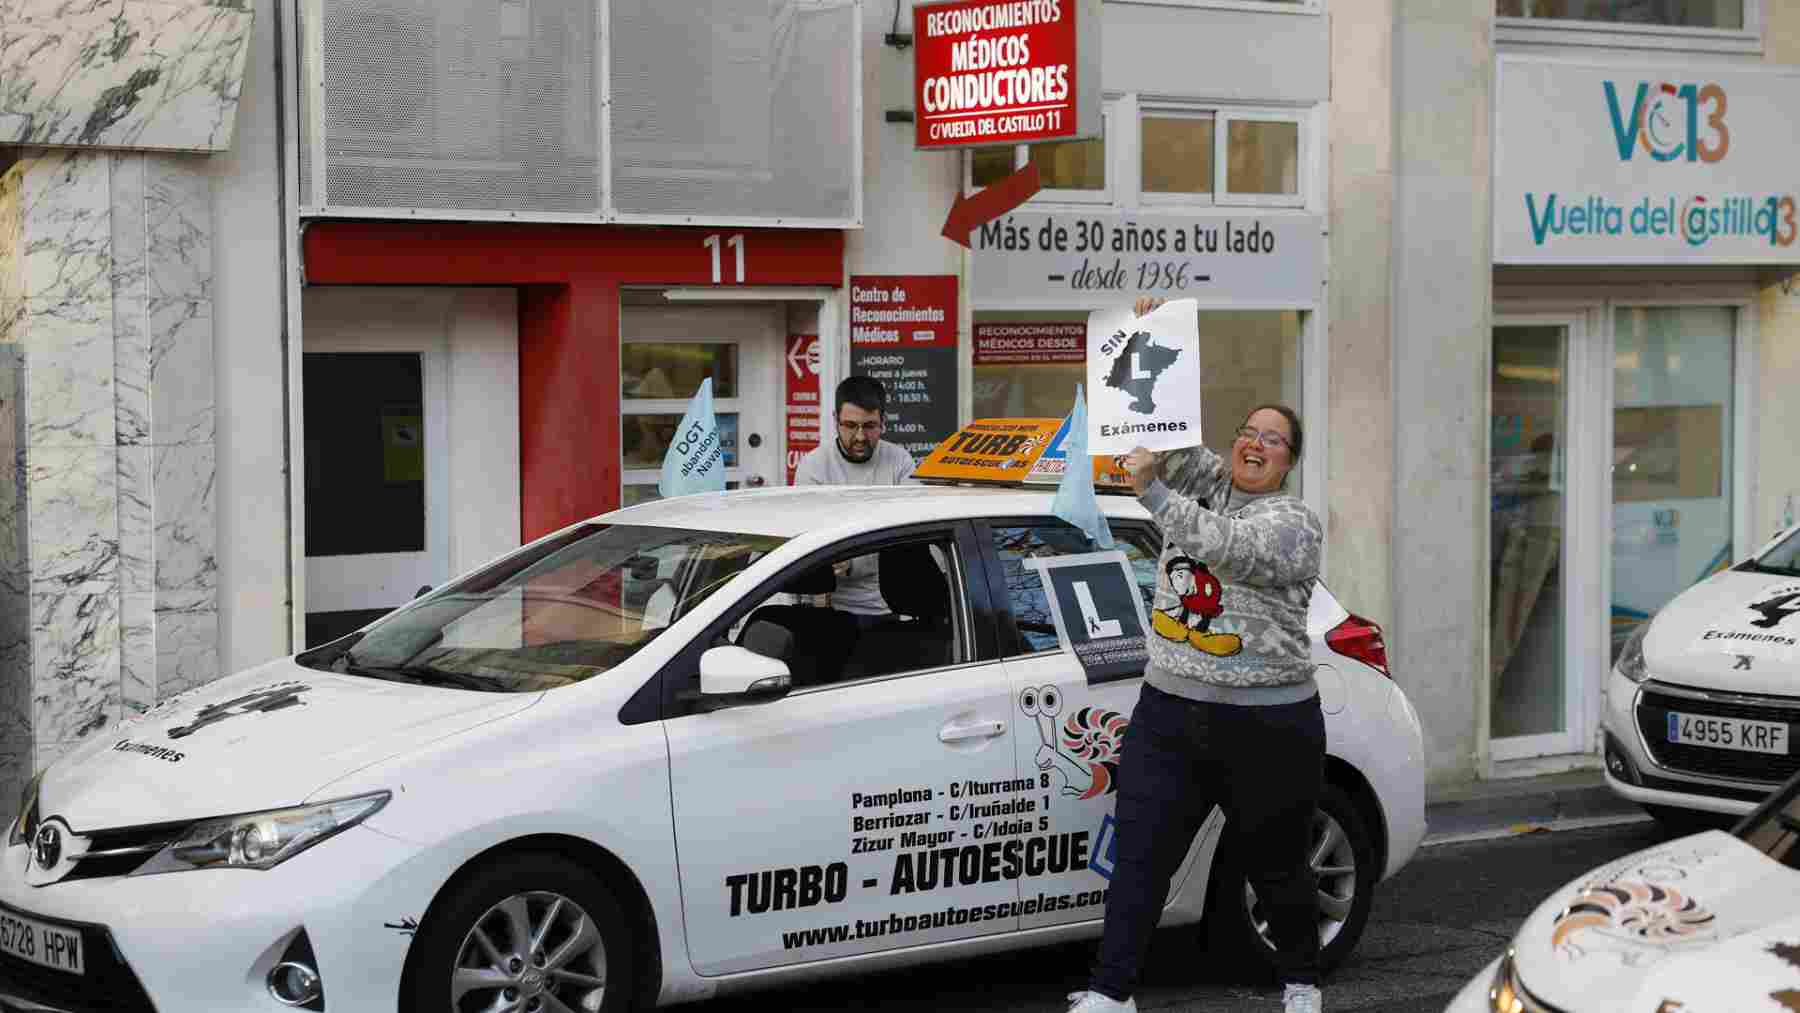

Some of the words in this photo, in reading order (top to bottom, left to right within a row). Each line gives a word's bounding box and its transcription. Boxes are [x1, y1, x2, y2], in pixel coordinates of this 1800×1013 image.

[927, 0, 1061, 37] RECONOCIMIENTOS
[951, 33, 1030, 72] MÉDICOS
[923, 64, 1069, 112] CONDUCTORES
[978, 118, 997, 136] DEL
[998, 114, 1045, 134] CASTILLO
[1046, 110, 1061, 131] 11
[980, 218, 1032, 252] Más
[1038, 217, 1068, 252] de
[1075, 220, 1105, 252] 30
[1110, 219, 1167, 253] años
[1174, 229, 1187, 252] a
[1194, 224, 1218, 253] tu
[1226, 221, 1275, 254] lado
[1525, 193, 1623, 246] Vuelta
[1630, 197, 1675, 235] del
[703, 233, 745, 284] 11
[1071, 257, 1129, 290] desde
[1135, 259, 1191, 290] 1986
[852, 286, 889, 303] Centro
[892, 286, 906, 302] de
[852, 306, 945, 323] Reconocimientos
[978, 326, 1085, 336] RECONOCIMIENTOS
[852, 326, 899, 343] Médicos
[1100, 329, 1127, 357] SIN
[1131, 352, 1152, 380] L
[676, 420, 704, 456] DGT
[1100, 421, 1188, 438] Exámenes
[1072, 581, 1124, 639] L
[1682, 717, 1734, 745] 4955
[1741, 724, 1785, 750] KRF
[852, 786, 933, 809] Pamplona
[950, 776, 1035, 799] C/Iturrama
[1039, 773, 1050, 789] 8
[852, 809, 931, 833] Berriozar
[949, 797, 1036, 822] C/Iruñalde
[1042, 795, 1050, 811] 1
[852, 836, 894, 854] Zizur
[900, 829, 954, 849] Mayor
[973, 818, 1033, 840] C/Idoia
[1038, 816, 1049, 832] 5
[725, 861, 848, 917] TURBO
[0, 915, 35, 956] 6728
[42, 928, 78, 969] HPW
